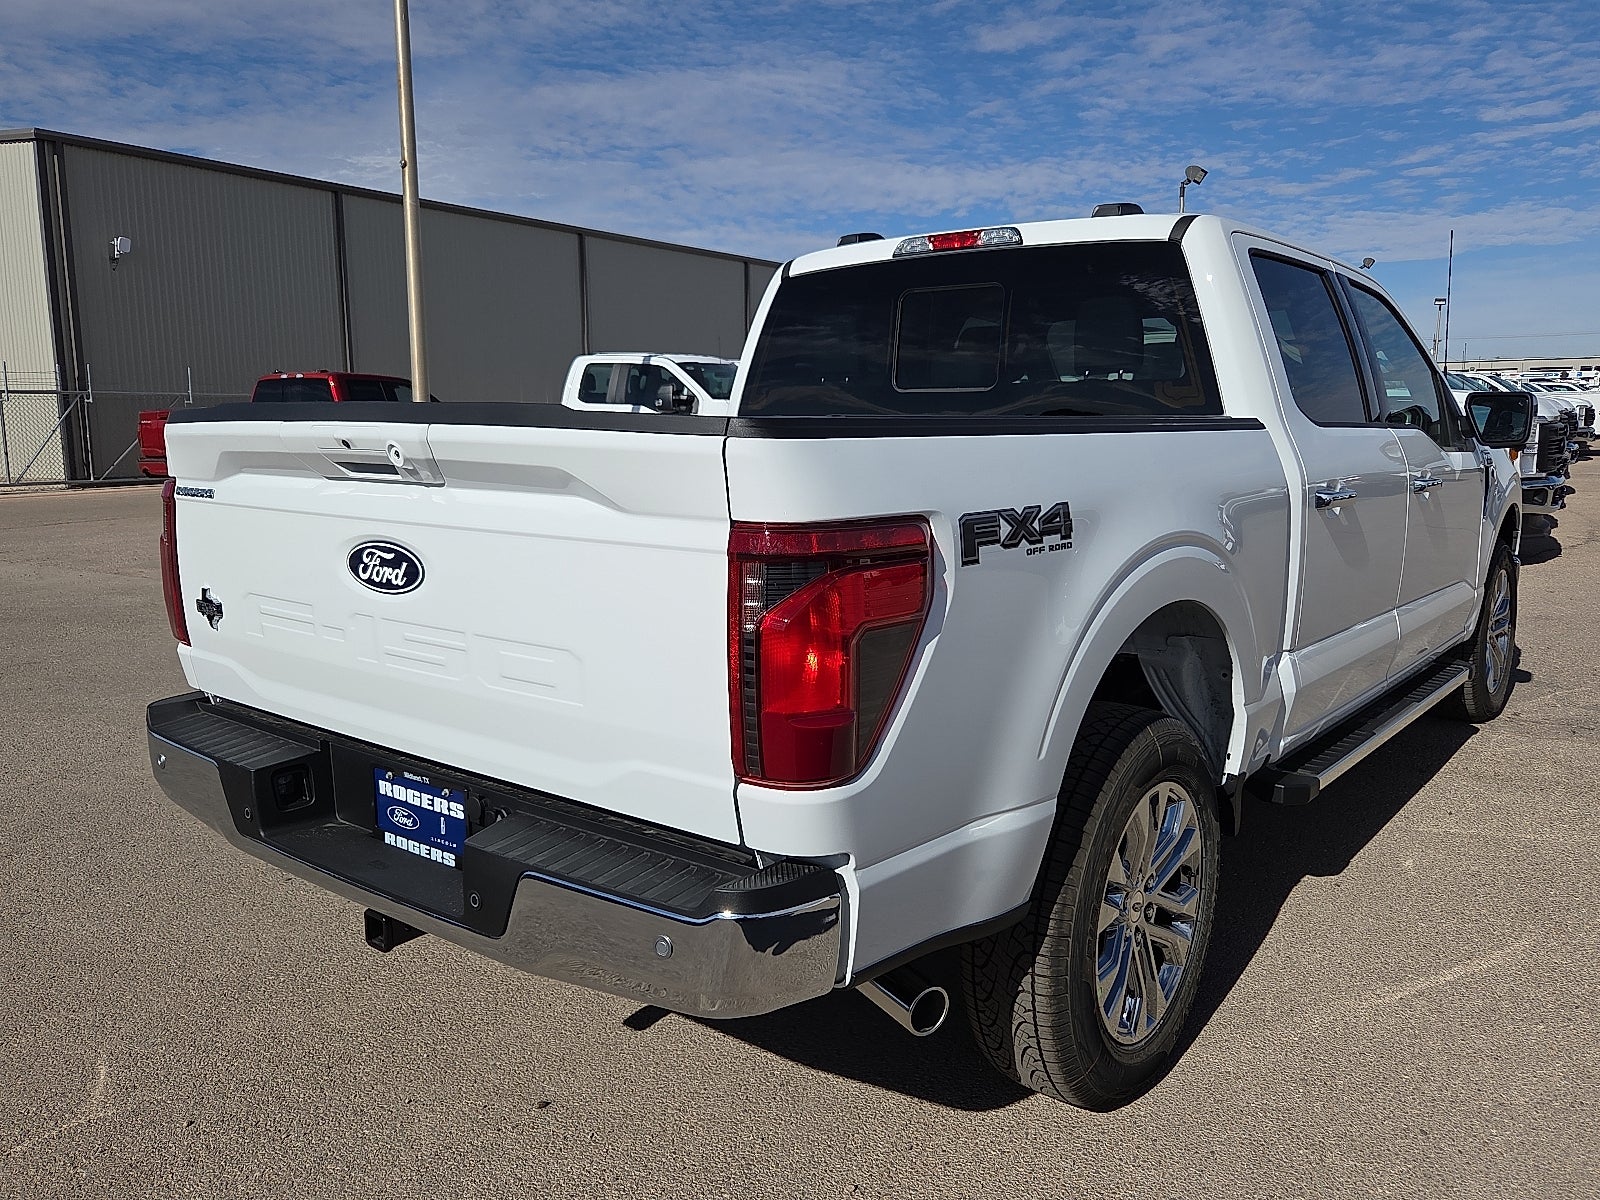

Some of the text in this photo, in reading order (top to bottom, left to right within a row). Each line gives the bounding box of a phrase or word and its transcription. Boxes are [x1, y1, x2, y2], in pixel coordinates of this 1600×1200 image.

[958, 501, 1073, 567] FX4
[1026, 542, 1073, 556] OFF ROAD
[358, 548, 408, 586] Ford
[378, 780, 465, 820] ROGERS
[393, 809, 414, 827] Ford
[384, 831, 456, 867] ROGERS
